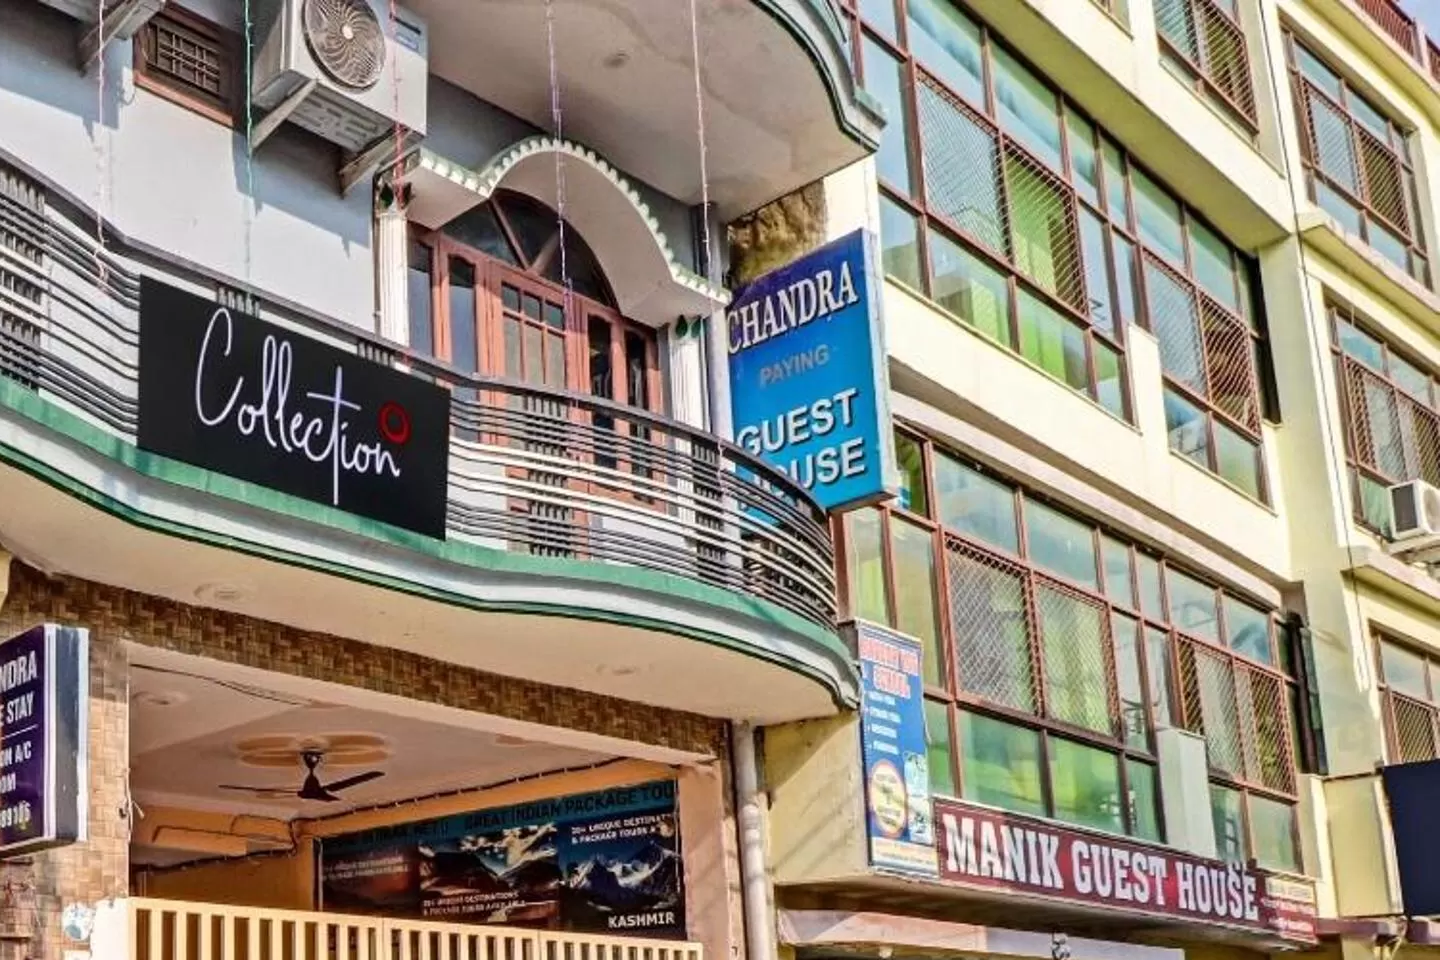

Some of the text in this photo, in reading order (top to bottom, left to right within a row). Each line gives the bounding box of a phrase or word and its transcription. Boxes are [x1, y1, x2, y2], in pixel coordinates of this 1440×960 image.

[726, 260, 859, 354] CHANDRA
[760, 344, 831, 387] PAYING
[195, 307, 401, 506] Collection
[737, 387, 858, 457] GUEST
[6, 691, 35, 725] STAY
[512, 802, 560, 822] INDIAN
[564, 790, 635, 815] PACKAGE
[942, 813, 1260, 922] MANIK GUEST HOUSE
[608, 911, 675, 929] KASHMIR
